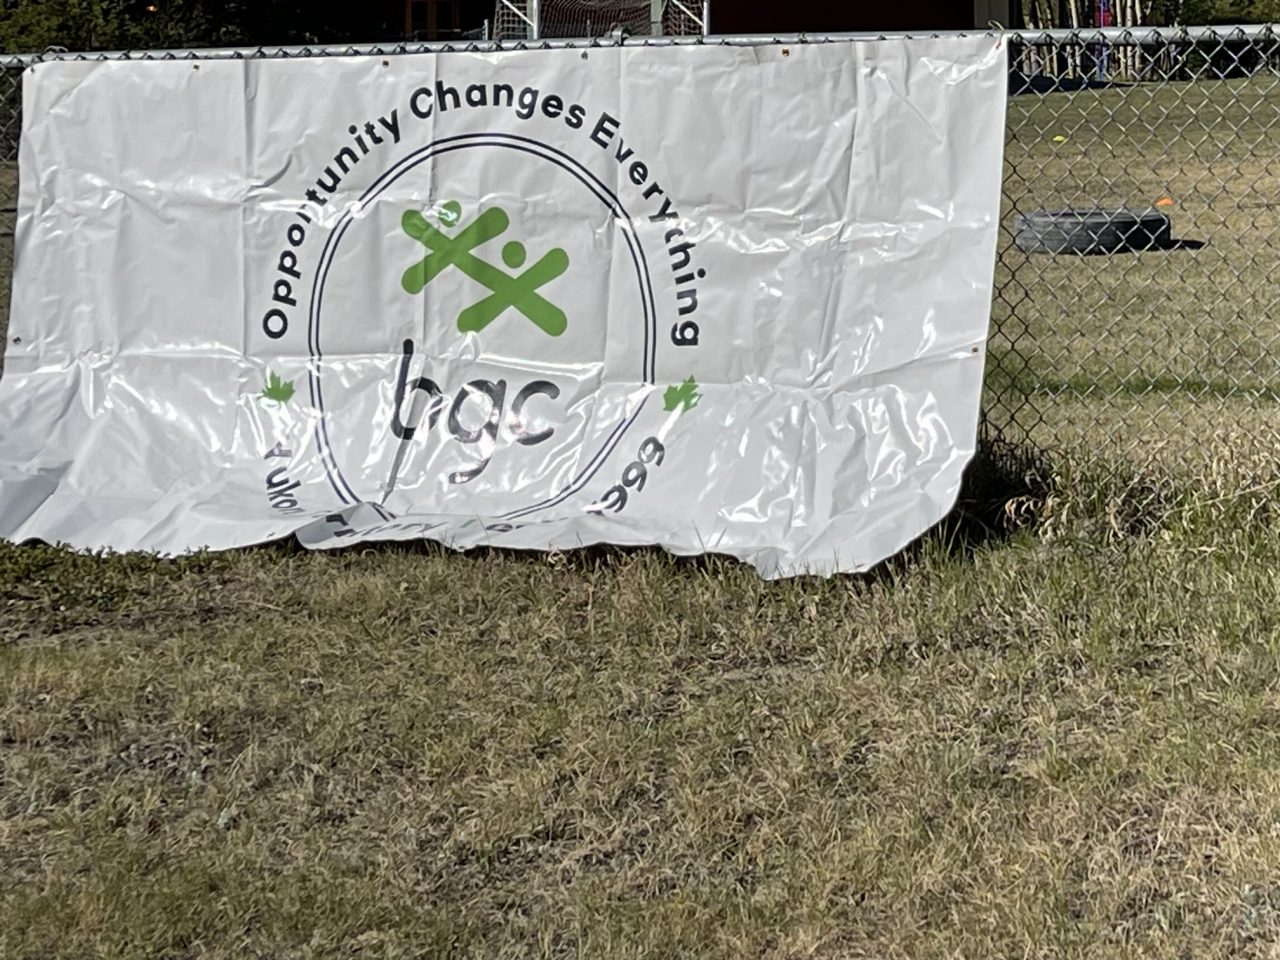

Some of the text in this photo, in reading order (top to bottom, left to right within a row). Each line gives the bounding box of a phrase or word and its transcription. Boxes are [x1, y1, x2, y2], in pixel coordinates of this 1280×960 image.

[262, 108, 401, 339] Opportunity
[410, 80, 586, 129] Changes
[391, 338, 560, 484] bgc
[586, 436, 665, 516] 999
